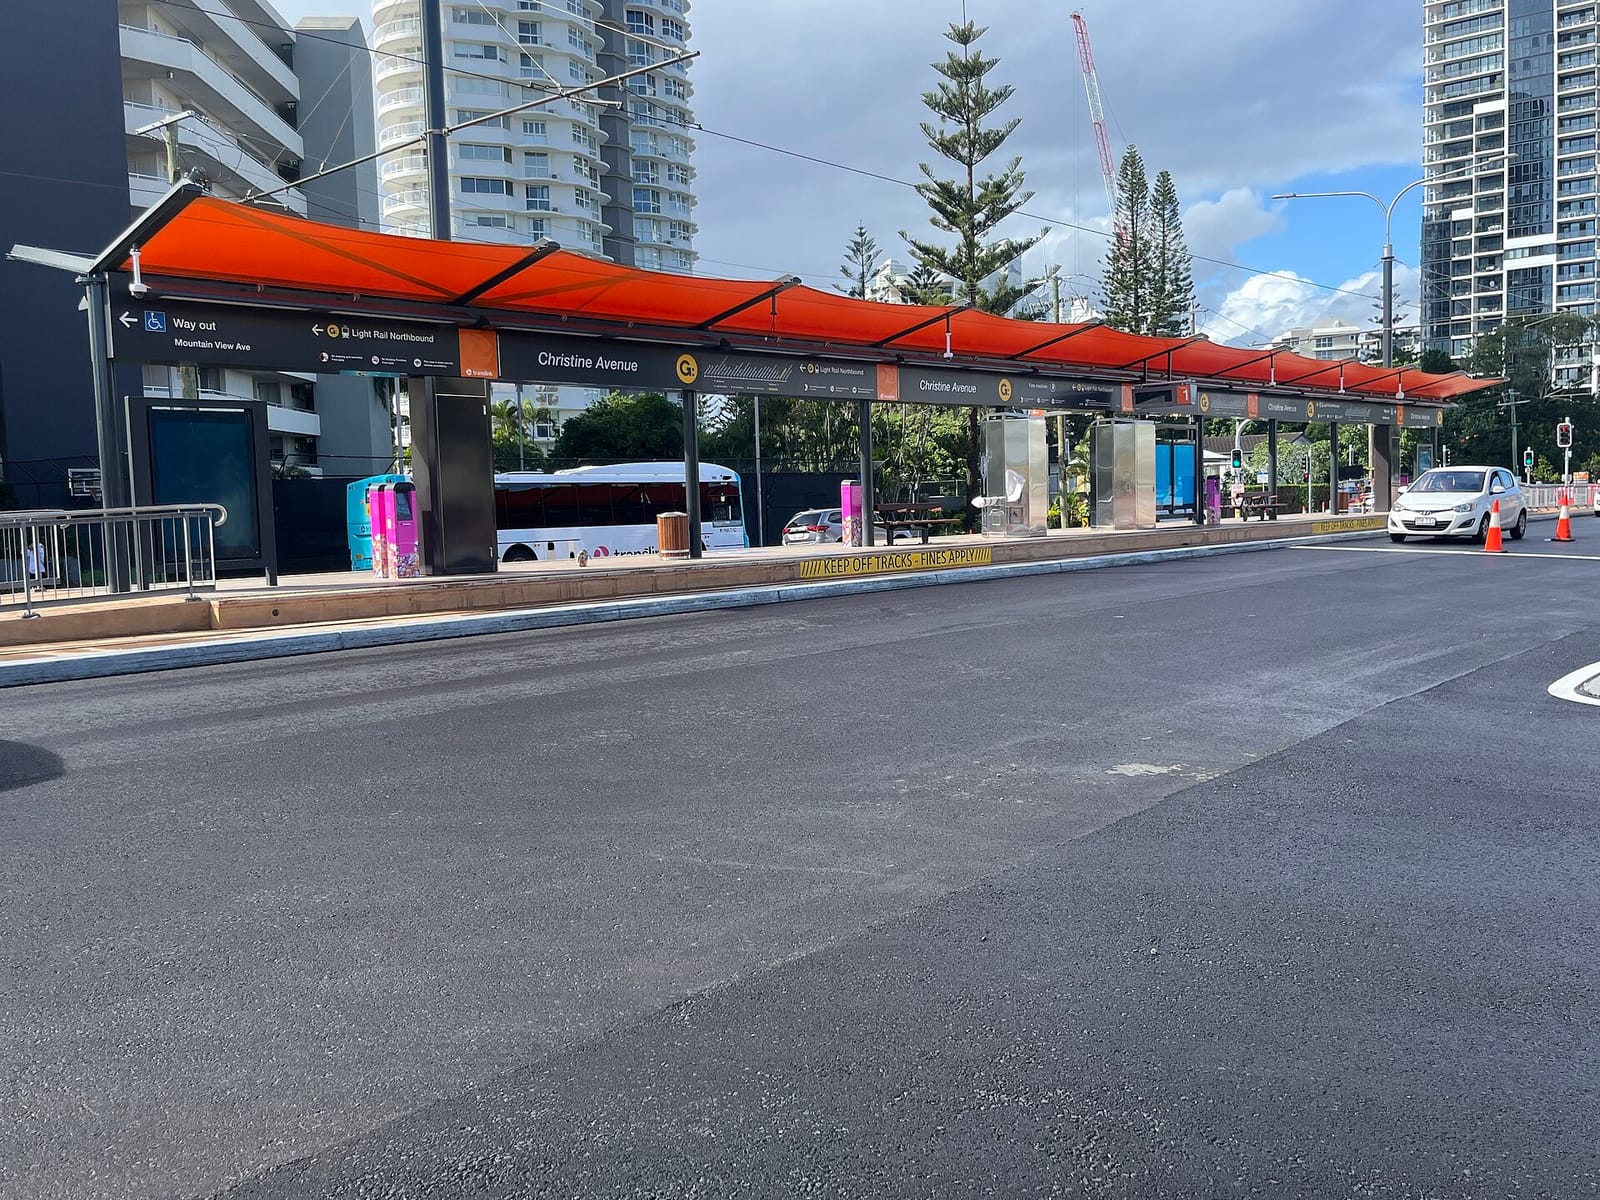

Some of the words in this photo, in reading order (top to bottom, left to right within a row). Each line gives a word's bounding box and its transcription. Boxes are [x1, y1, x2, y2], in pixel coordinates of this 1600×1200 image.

[173, 318, 196, 331] Way
[199, 321, 217, 331] out
[352, 329, 372, 340] Light
[373, 330, 388, 339] Rail
[389, 332, 434, 343] Northbound
[174, 338, 213, 348] Mountain
[214, 341, 234, 350] View
[235, 343, 251, 351] Ave
[538, 351, 593, 369] Christine
[595, 356, 638, 372] Avenue
[920, 379, 951, 392] Christine
[951, 382, 977, 394] Avenue
[1183, 389, 1189, 401] 1
[824, 560, 850, 574] KEEP
[853, 557, 873, 572] OFF
[875, 554, 912, 570] TRACKS
[921, 551, 946, 566] FINES
[948, 549, 975, 563] APPLY
